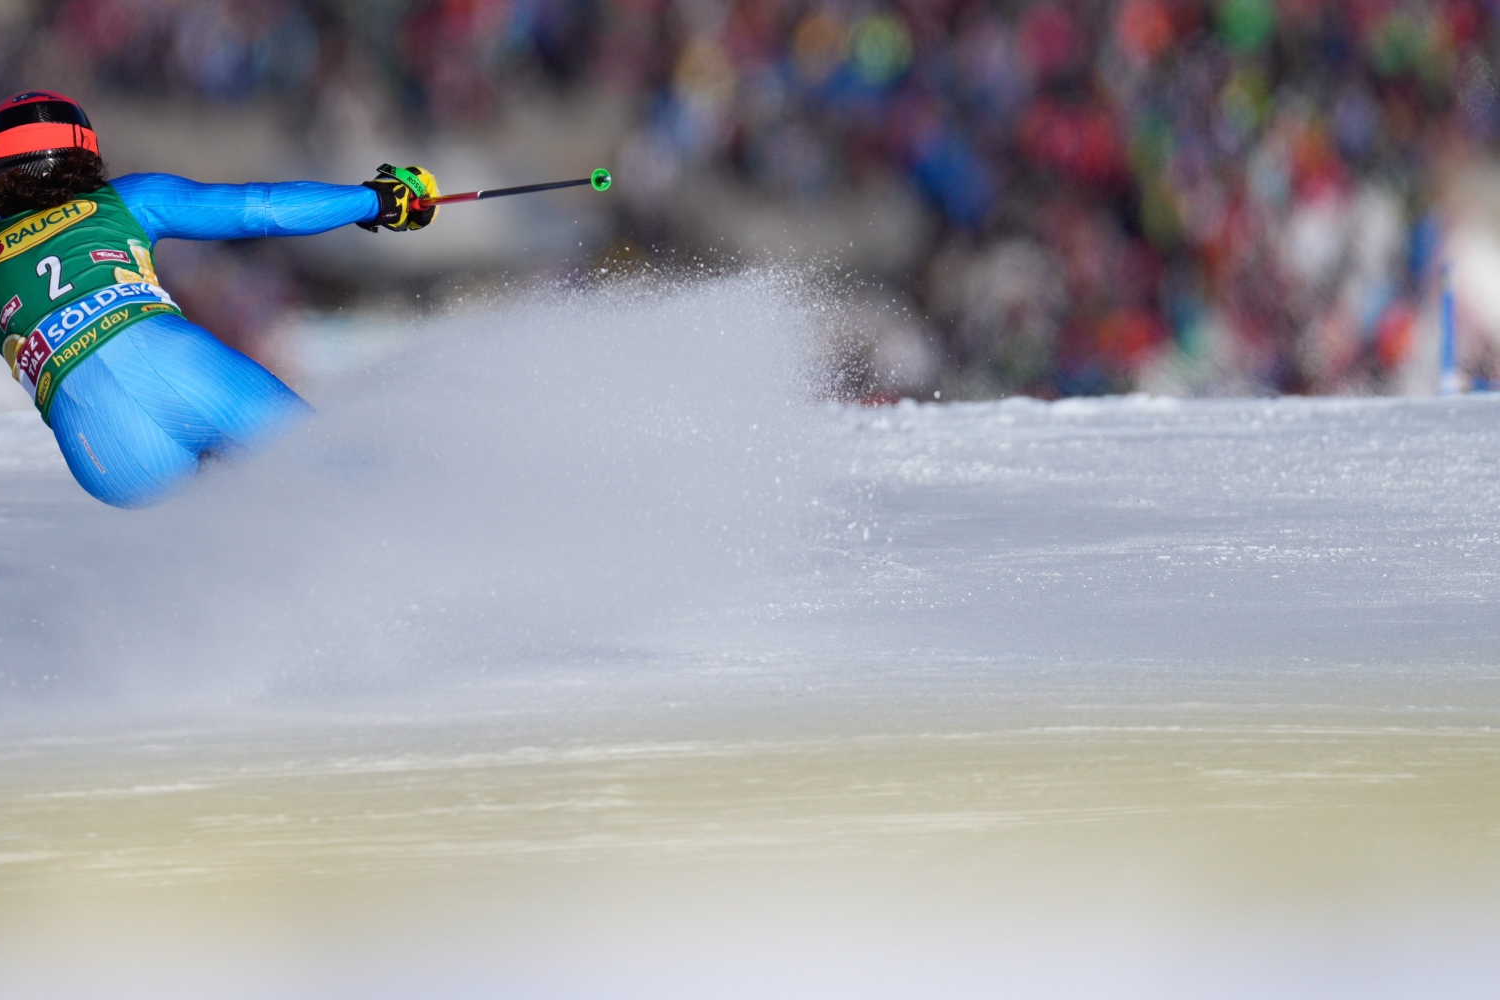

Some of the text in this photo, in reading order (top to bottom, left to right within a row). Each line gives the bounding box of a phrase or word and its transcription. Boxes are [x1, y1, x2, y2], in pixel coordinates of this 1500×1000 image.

[4, 203, 81, 249] RAUCH
[35, 255, 75, 301] 2
[47, 282, 151, 343] SÖLDEN
[52, 308, 129, 367] happy day
[28, 350, 45, 377] TAL
